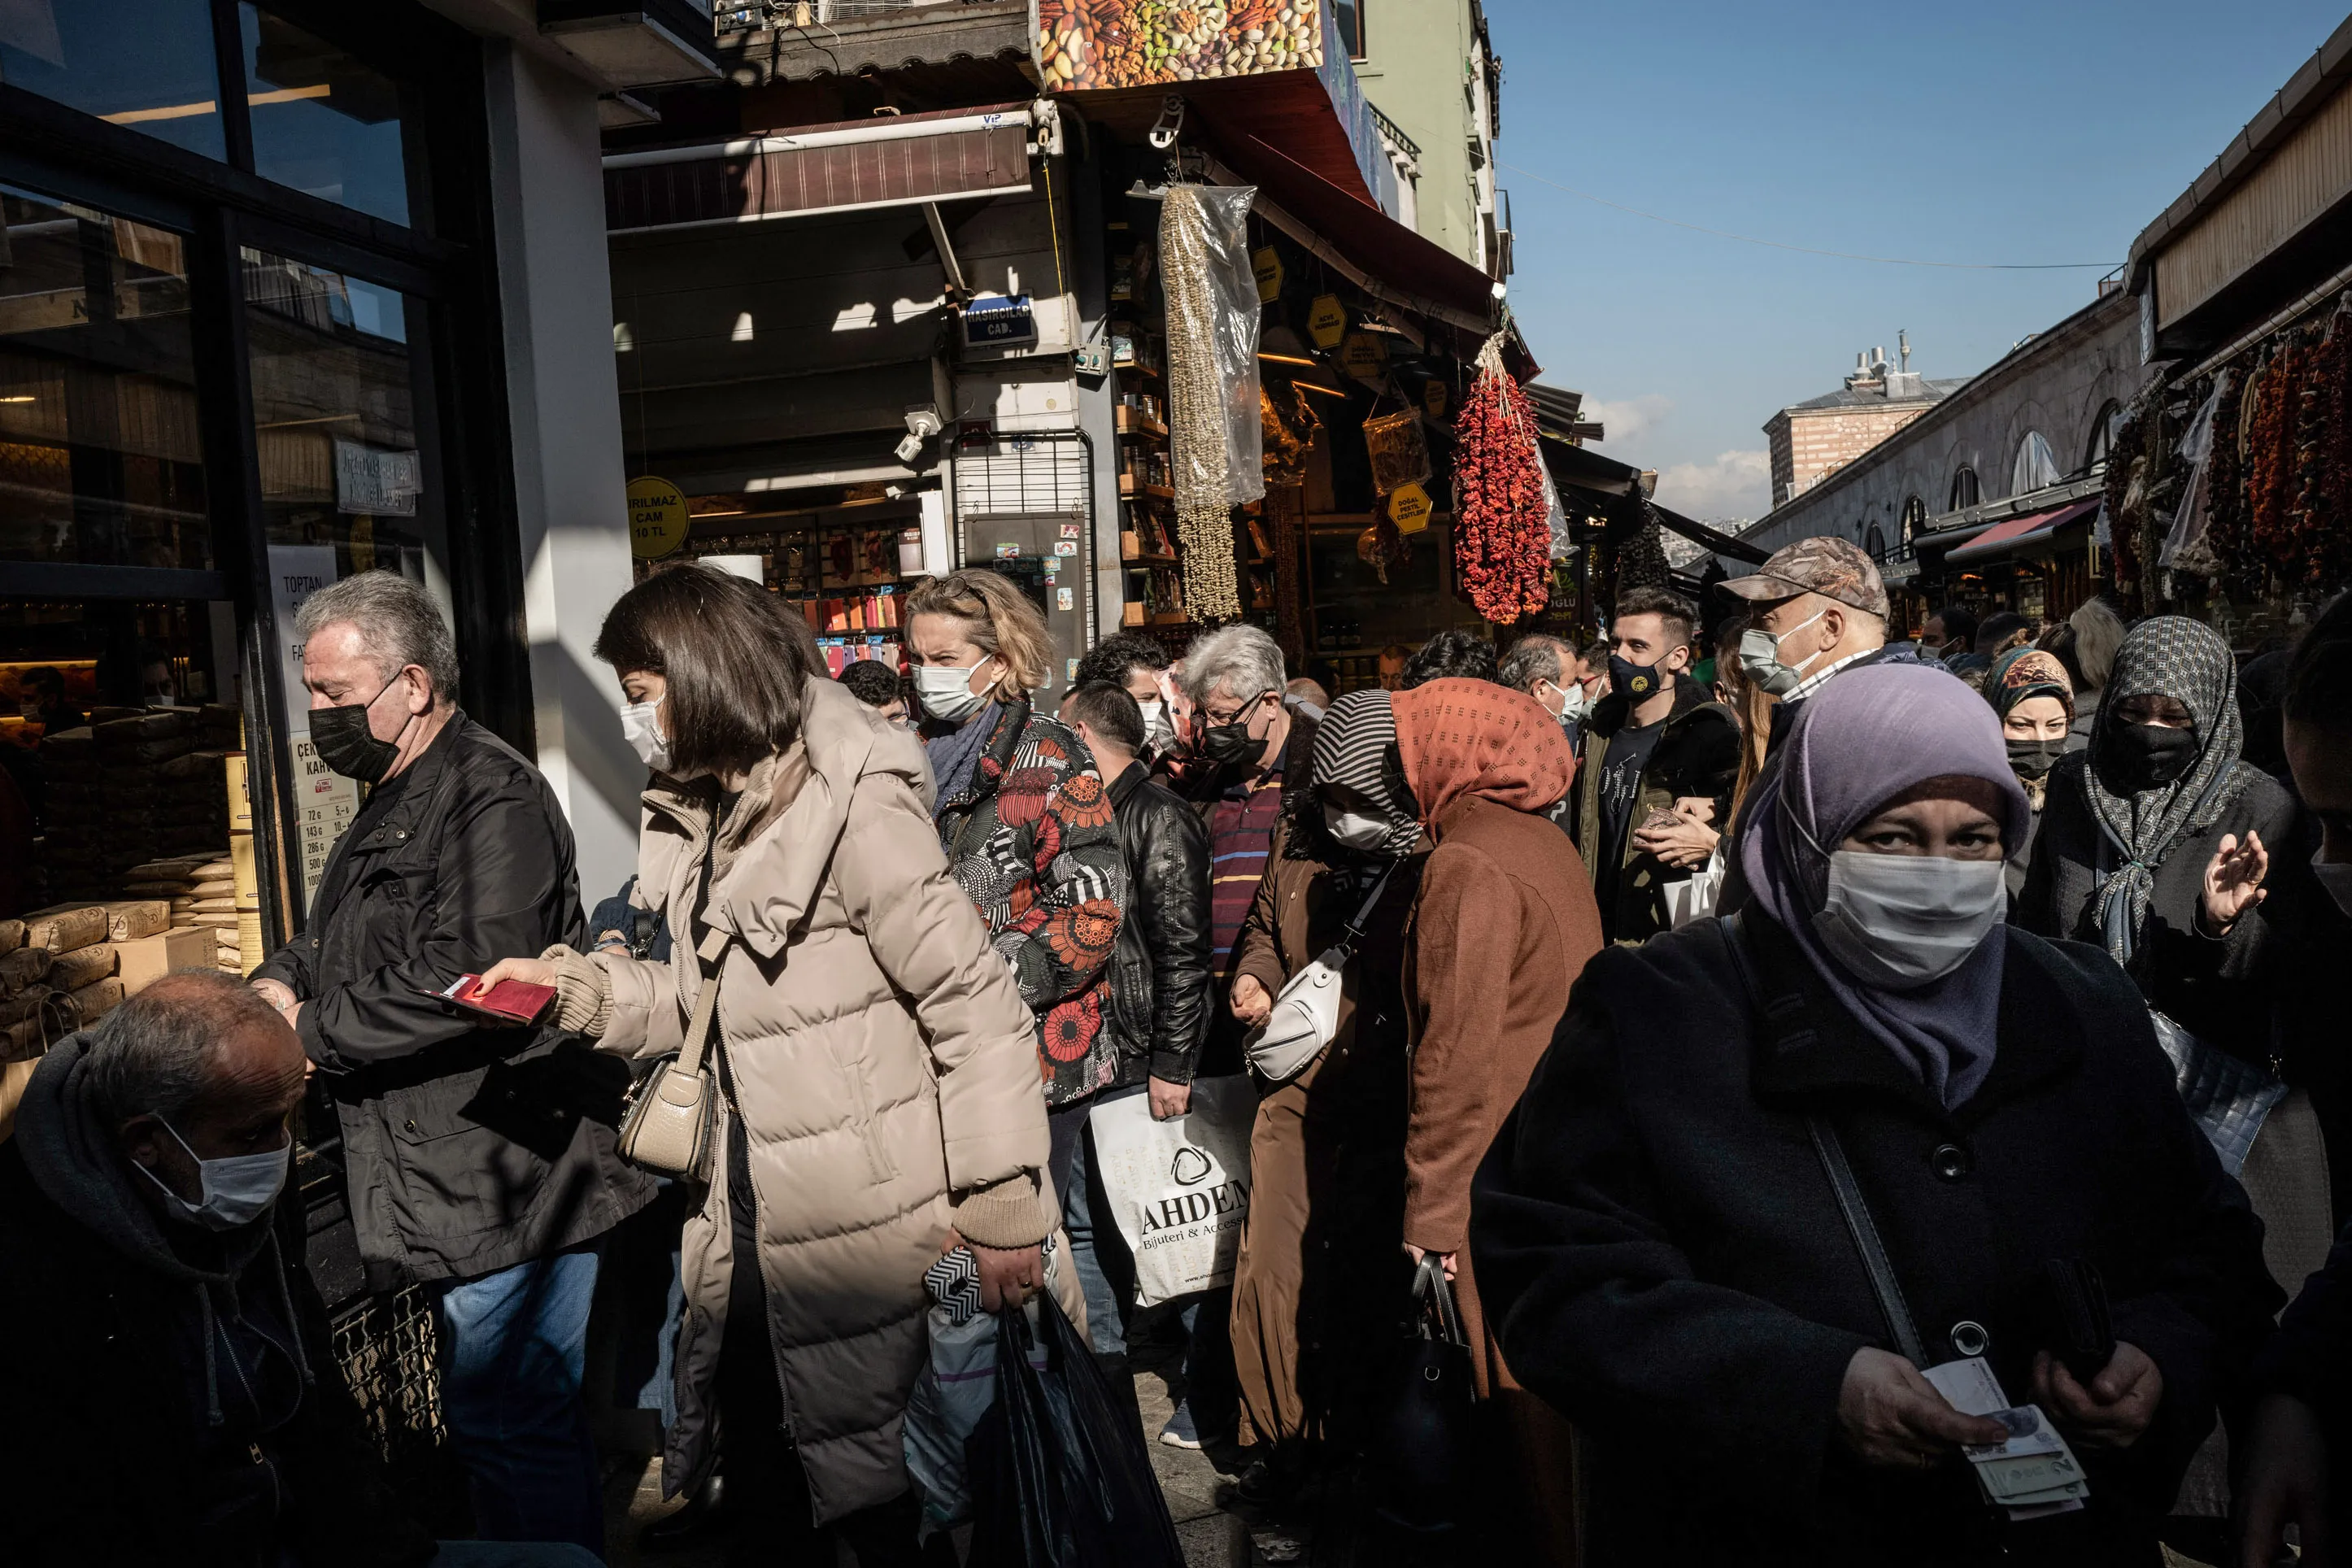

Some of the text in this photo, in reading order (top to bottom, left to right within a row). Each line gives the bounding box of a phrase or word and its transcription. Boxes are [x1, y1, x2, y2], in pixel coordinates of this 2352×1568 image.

[967, 305, 1030, 323] HASIRCILAR
[987, 322, 1013, 335] CAD.
[629, 495, 677, 508] IRILMAZ
[1398, 496, 1418, 506] DOĞAL
[635, 512, 663, 523] CAM
[635, 526, 666, 538] 10 TL
[283, 576, 322, 593] TOPTAN
[298, 743, 317, 761] ÇEK
[308, 810, 316, 821] 72
[307, 826, 317, 837] 143
[308, 843, 319, 853] 286
[310, 858, 320, 869] 500
[1143, 1217, 1244, 1250] Bijuteri & Access
